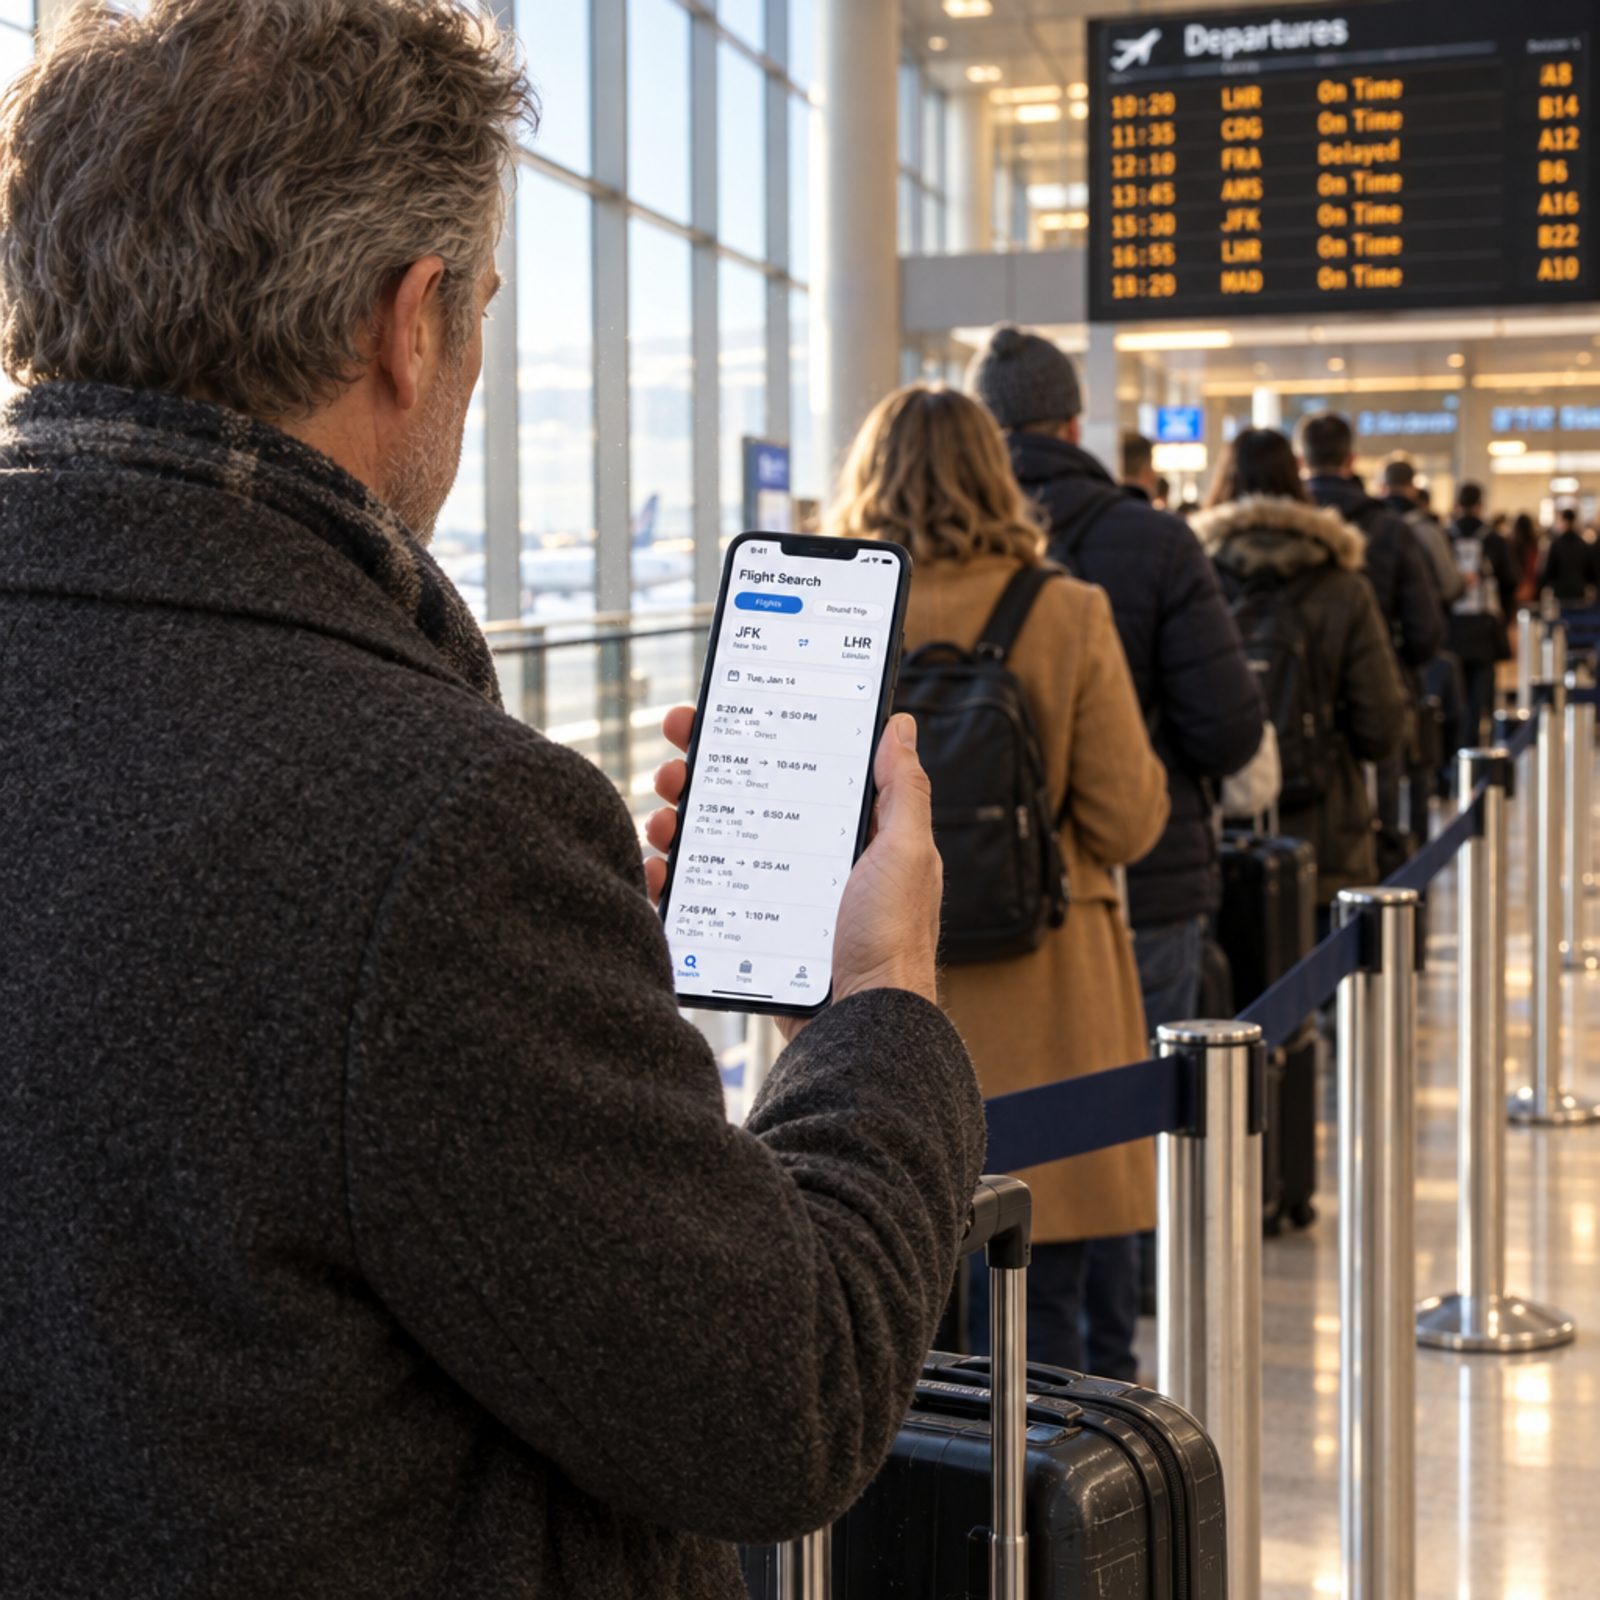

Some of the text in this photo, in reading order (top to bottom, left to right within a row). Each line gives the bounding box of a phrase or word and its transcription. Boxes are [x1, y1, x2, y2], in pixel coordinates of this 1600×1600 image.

[1184, 19, 1348, 60] Departures
[1318, 80, 1347, 103] On
[1352, 77, 1403, 100] Time
[1540, 62, 1573, 86] A8
[1318, 112, 1347, 134] On
[1352, 108, 1403, 131] Time
[1539, 95, 1579, 119] B14
[1318, 139, 1400, 167] Delayed
[1538, 127, 1579, 151] A12
[1317, 173, 1347, 196] On
[1352, 171, 1403, 193] Time
[1538, 160, 1568, 184] B6
[1222, 208, 1260, 231] JFK
[1317, 204, 1347, 227] On
[1352, 202, 1403, 225] Time
[1538, 192, 1579, 215] A16
[1317, 235, 1347, 257] On
[1352, 233, 1403, 256] Time
[1538, 224, 1579, 248] B22
[1317, 267, 1347, 289] On
[1352, 264, 1403, 288] Time
[1538, 257, 1579, 280] A10
[739, 569, 821, 587] Flight Search
[755, 598, 782, 609] Flights
[826, 605, 868, 616] Round Trip
[735, 627, 762, 640] JFK
[843, 636, 872, 650] LHR
[746, 673, 795, 686] Tue, Jan 14
[716, 704, 737, 714] 8:20
[738, 706, 754, 715] AM
[802, 712, 817, 721] PM
[733, 756, 748, 765] AM
[776, 760, 801, 770] 10:45
[802, 762, 817, 771] PM
[745, 780, 768, 790] Direct
[720, 806, 735, 815] PM
[763, 810, 783, 820] 6:50
[784, 812, 800, 821] AM
[710, 856, 725, 865] PM
[774, 862, 790, 871] AM
[701, 906, 717, 915] PM
[745, 911, 763, 920] 1:10
[764, 913, 780, 922] PM
